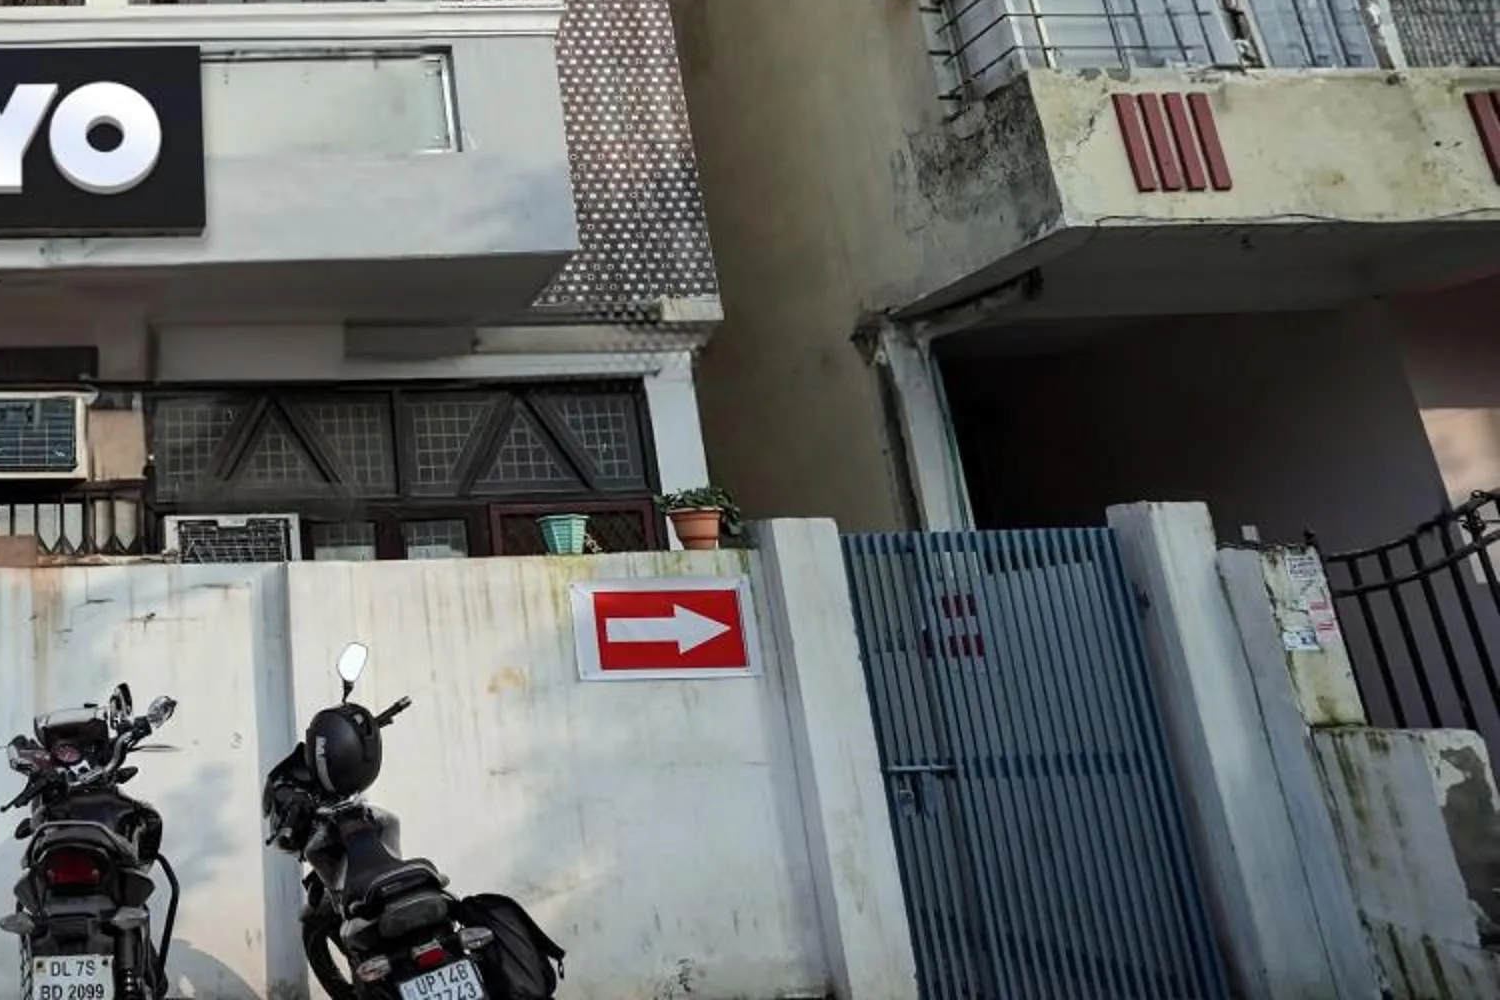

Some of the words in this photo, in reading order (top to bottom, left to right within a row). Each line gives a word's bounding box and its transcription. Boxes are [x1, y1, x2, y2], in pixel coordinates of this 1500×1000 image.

[51, 961, 71, 977] DL
[76, 960, 96, 976] 7S
[40, 985, 63, 1000] BD
[68, 984, 105, 1000] 2099
